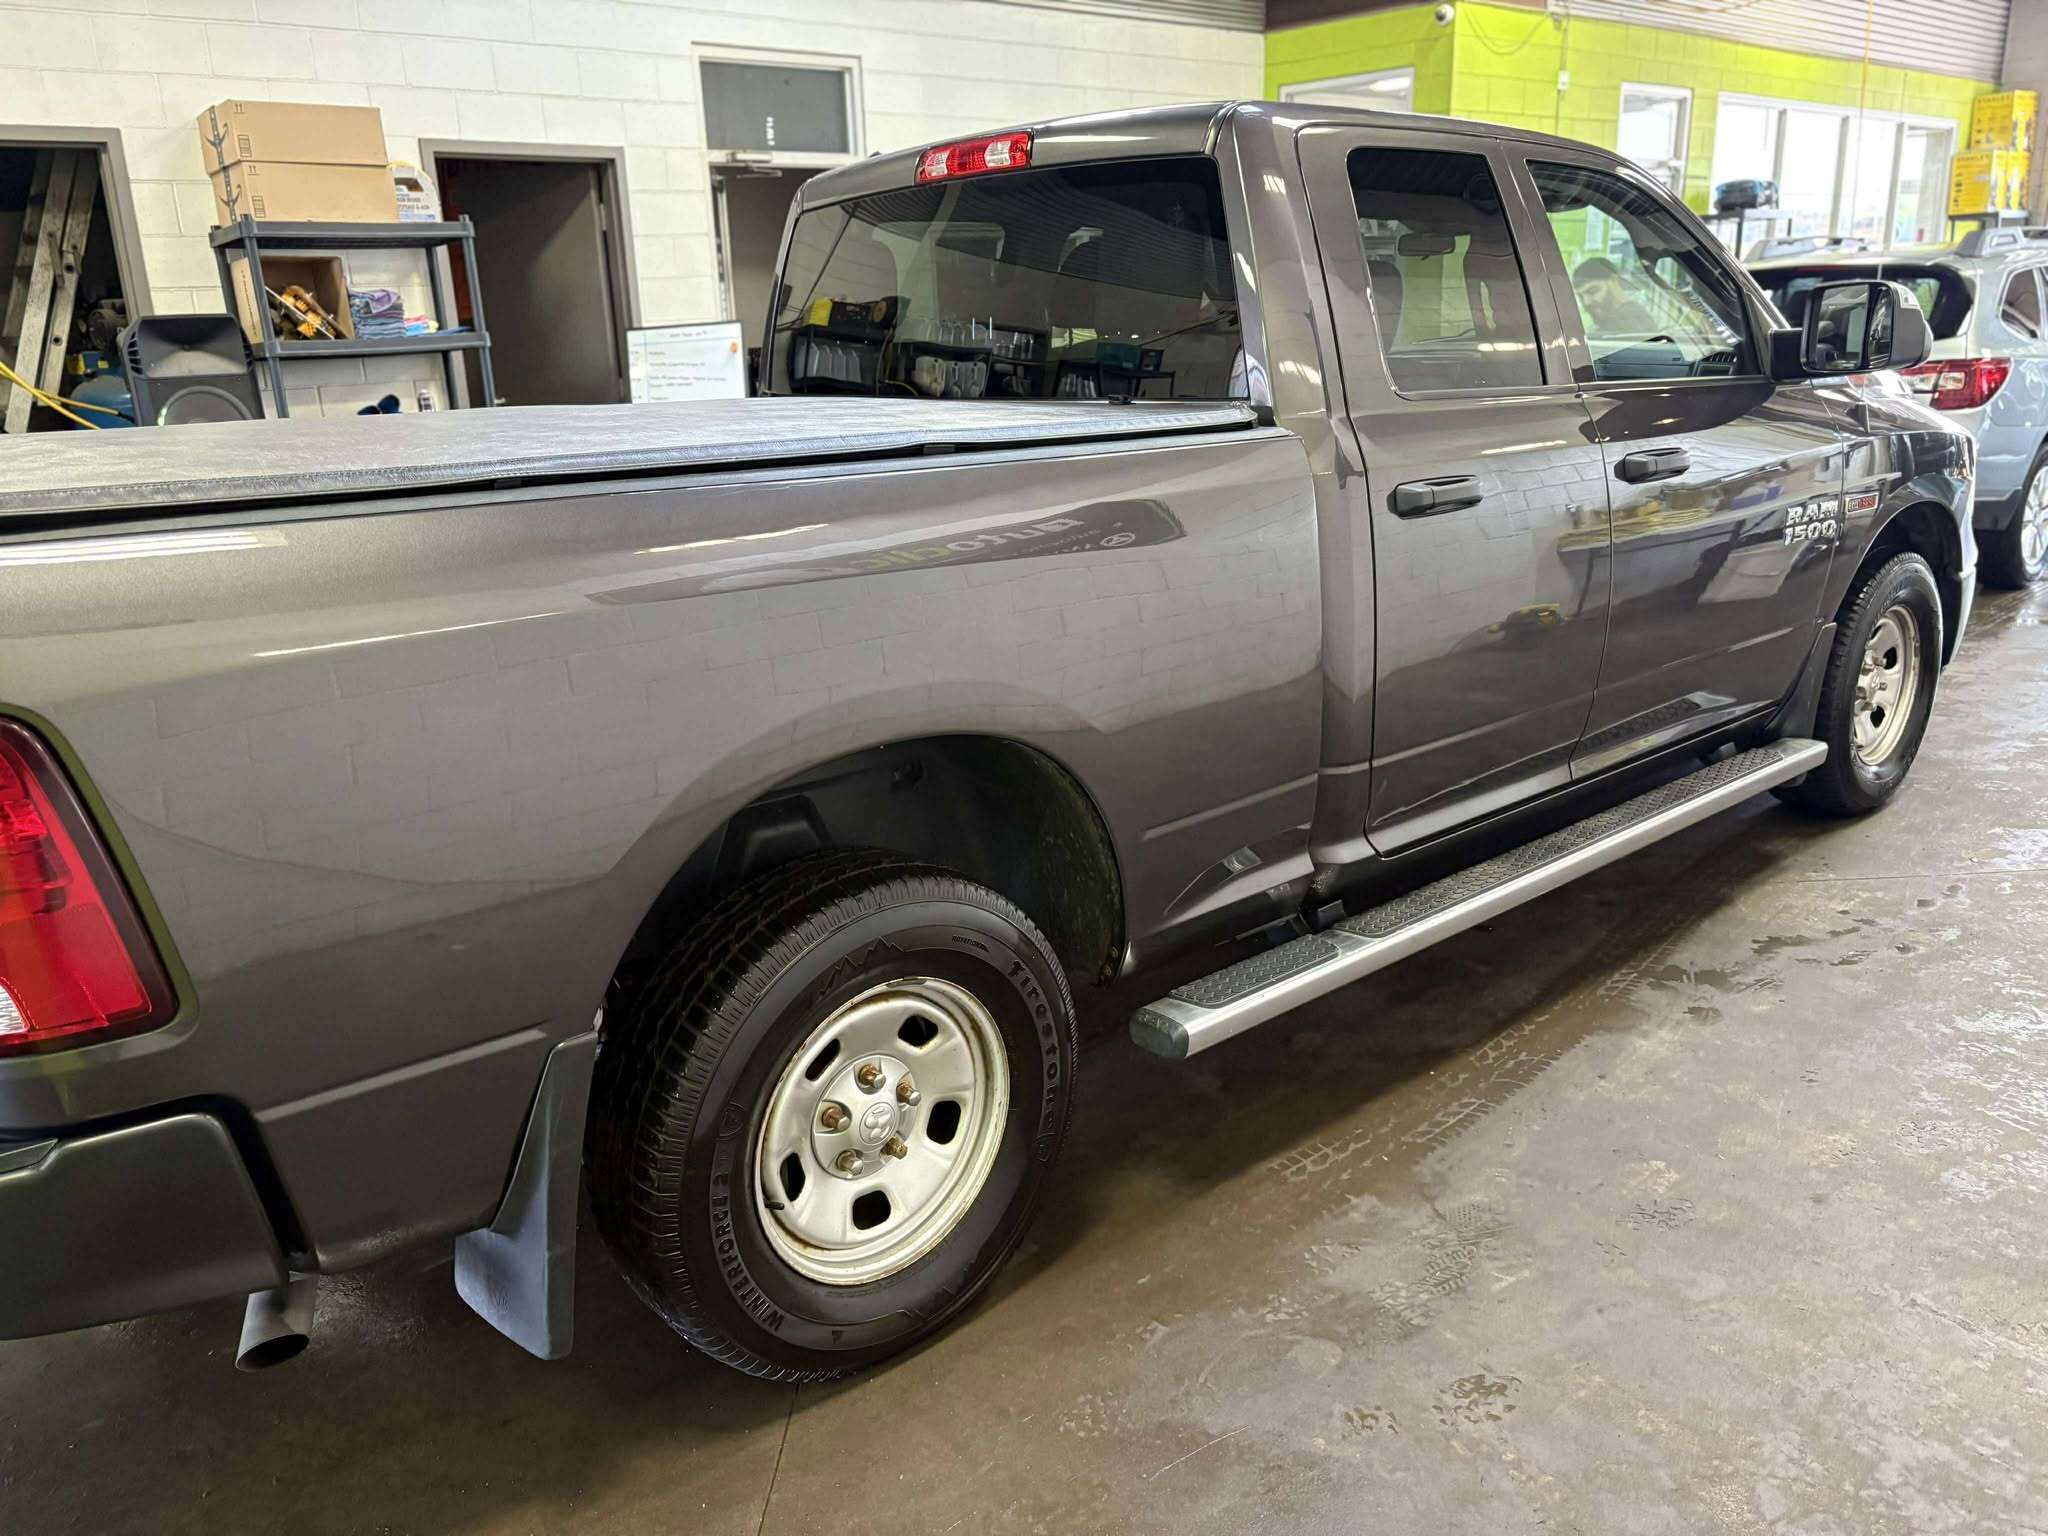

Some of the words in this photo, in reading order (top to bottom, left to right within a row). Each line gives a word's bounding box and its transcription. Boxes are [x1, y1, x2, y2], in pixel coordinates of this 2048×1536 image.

[1786, 500, 1839, 526] RAM
[1784, 519, 1837, 546] 1500
[711, 1194, 786, 1333] WINTERFORCE
